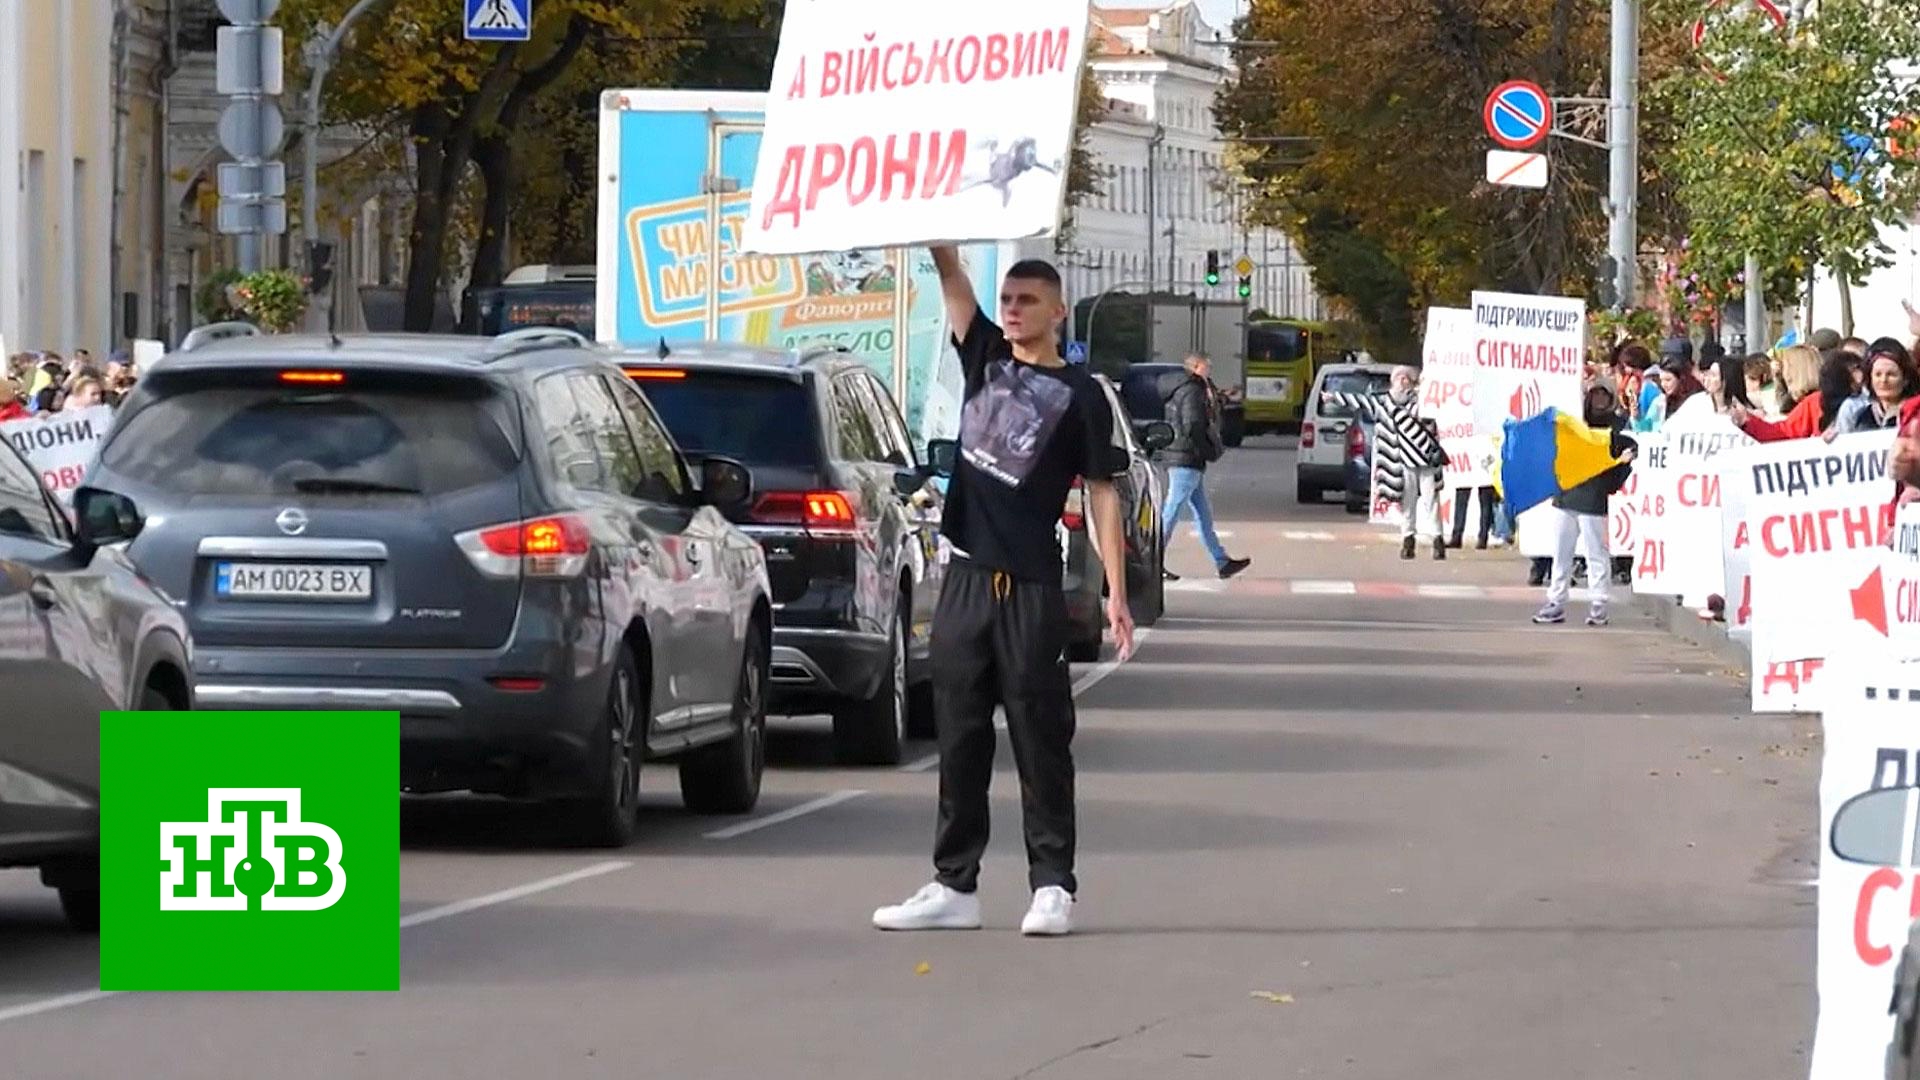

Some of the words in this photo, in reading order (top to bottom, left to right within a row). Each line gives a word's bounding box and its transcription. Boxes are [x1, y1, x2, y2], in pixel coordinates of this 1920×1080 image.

[787, 55, 805, 98] А
[820, 26, 1069, 98] ВІЙСЬКОВИМ
[761, 128, 967, 231] ДРОНИ
[1476, 303, 1579, 332] ПІДТРИМУЄШ!?
[1476, 338, 1578, 375] СИГНАЛЬ!!!
[1677, 473, 1721, 507] СИ
[271, 570, 324, 592] 0023
